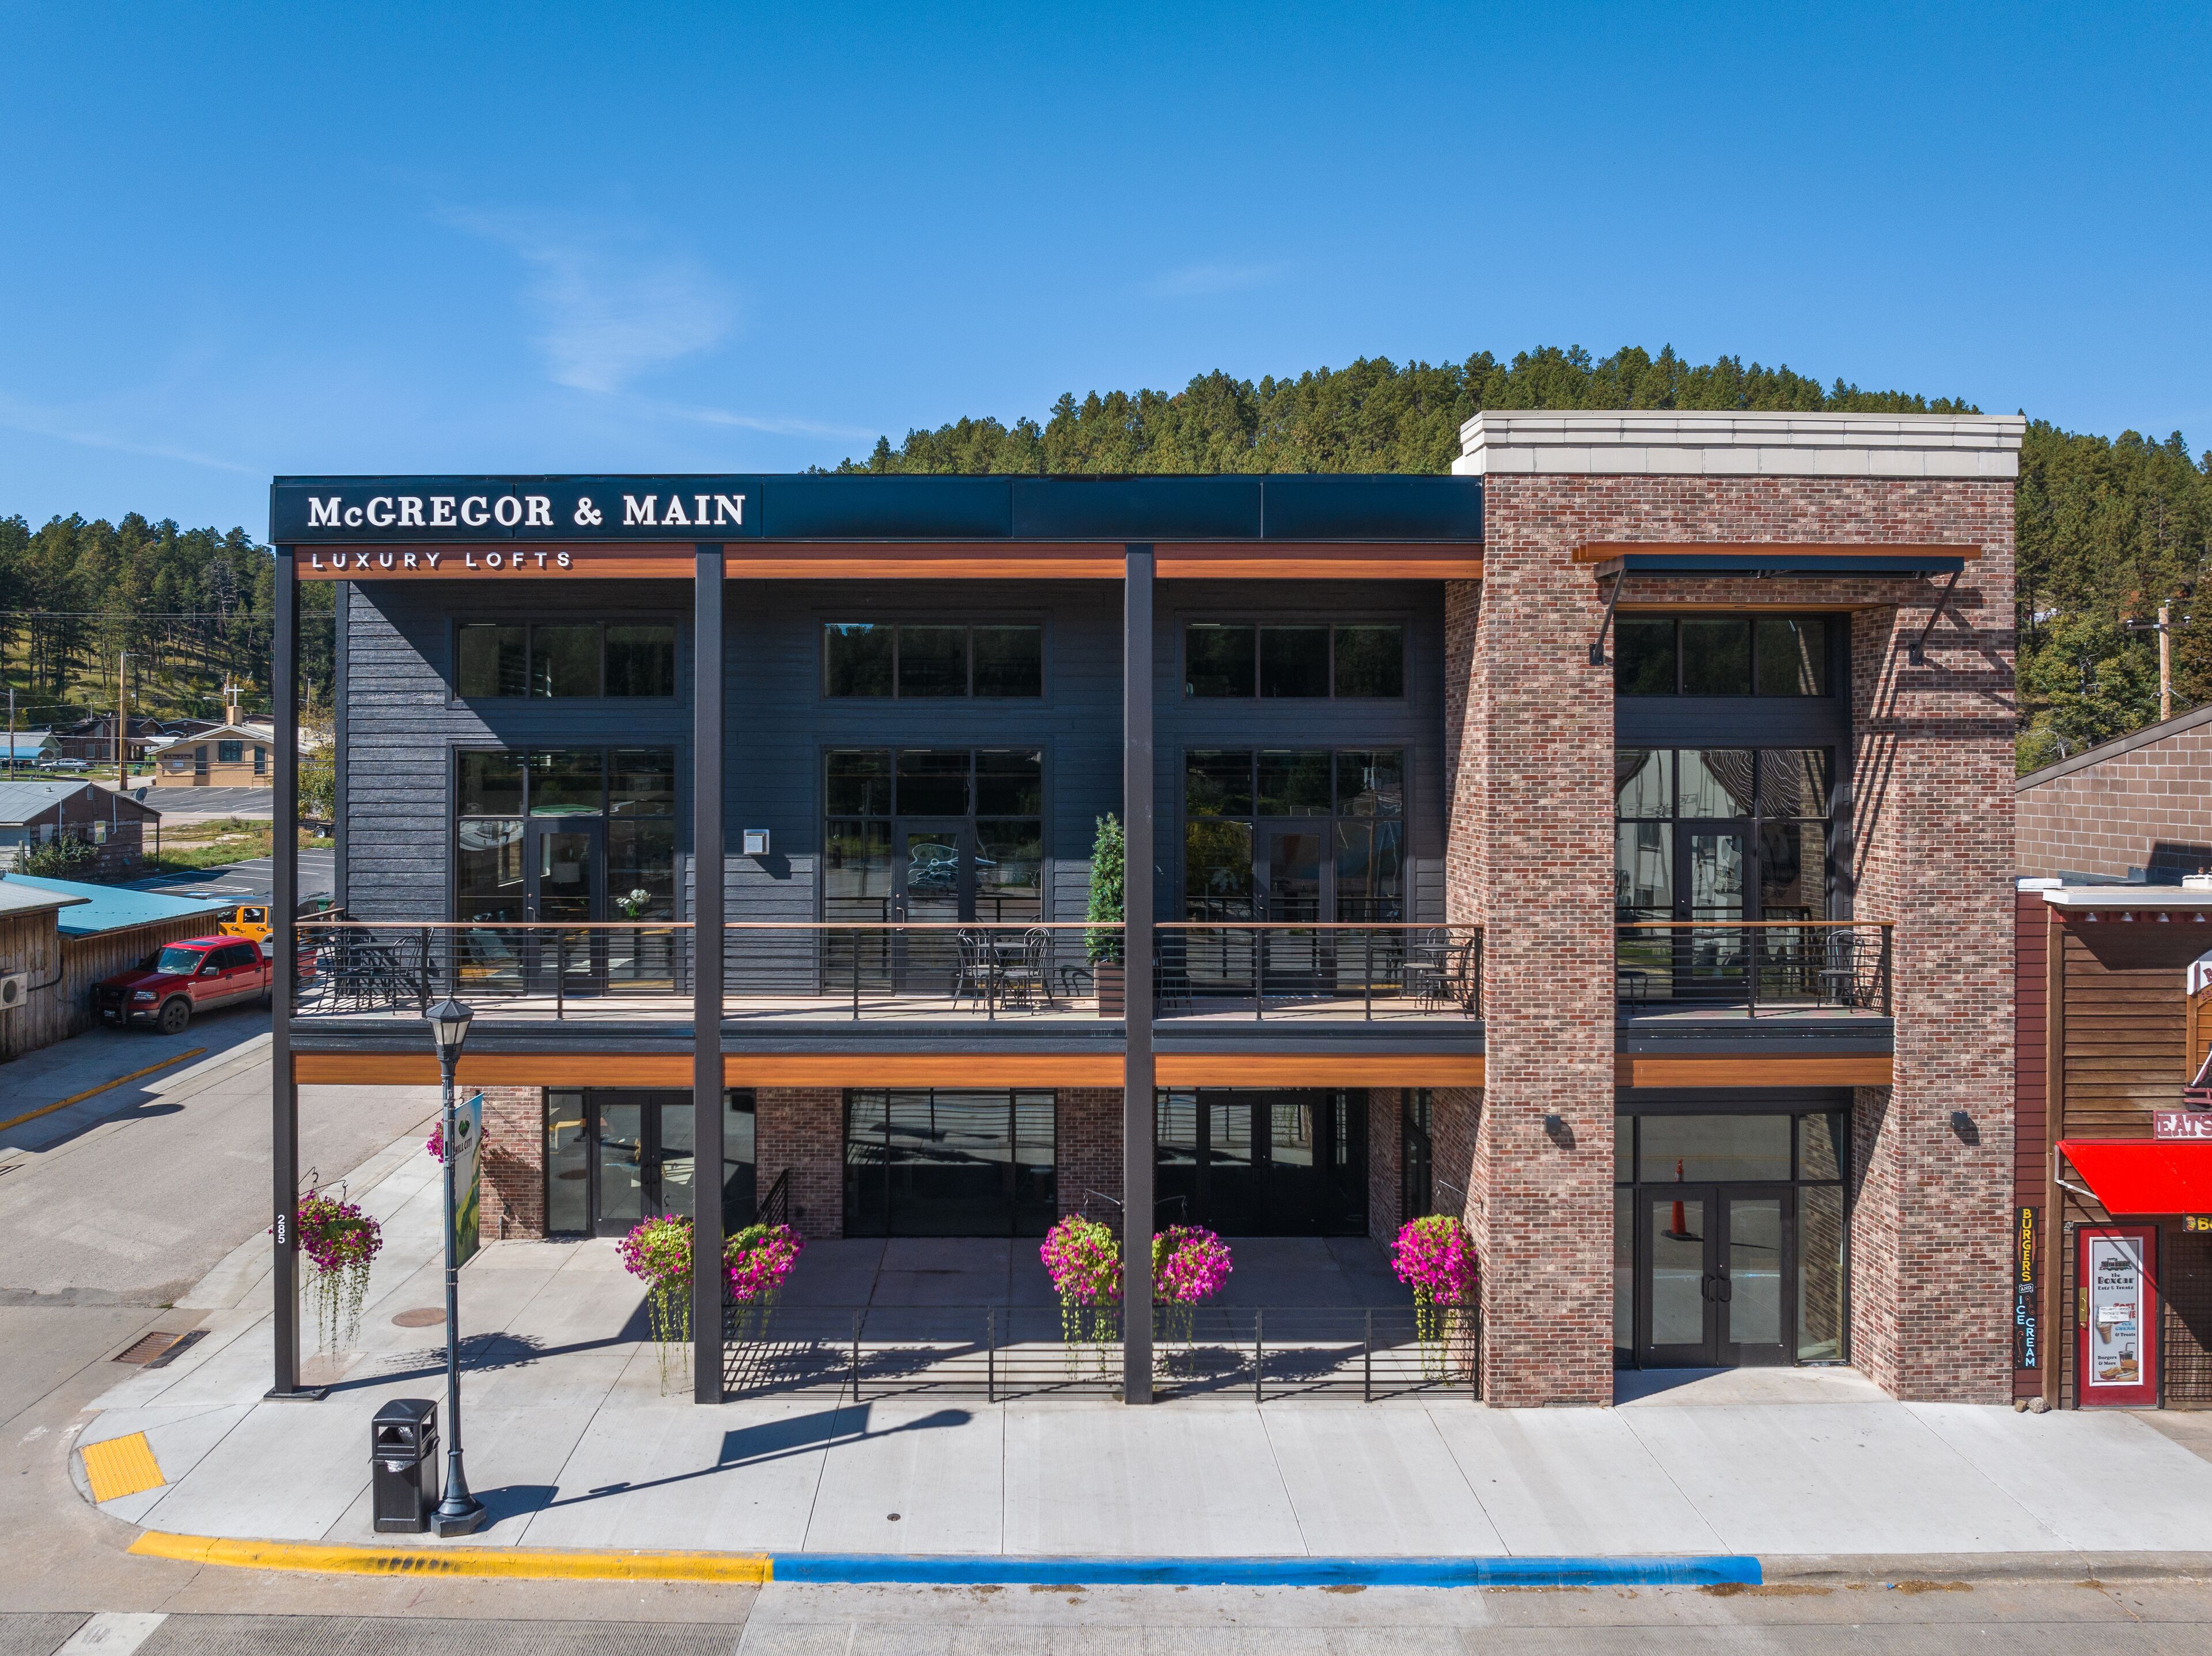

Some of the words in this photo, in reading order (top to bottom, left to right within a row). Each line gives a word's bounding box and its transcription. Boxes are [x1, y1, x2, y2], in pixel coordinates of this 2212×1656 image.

[308, 496, 554, 526] McGREGOR
[574, 497, 603, 526] &
[623, 495, 745, 525] MAIN
[312, 552, 440, 568] LUXURY
[465, 552, 570, 567] LOFTS
[2158, 1115, 2212, 1136] EATS
[455, 1142, 464, 1155] HILL
[464, 1136, 472, 1149] CITY
[2022, 1208, 2032, 1282] BURGERS
[2016, 1295, 2025, 1325] ICE
[2025, 1318, 2036, 1367] CREAM
